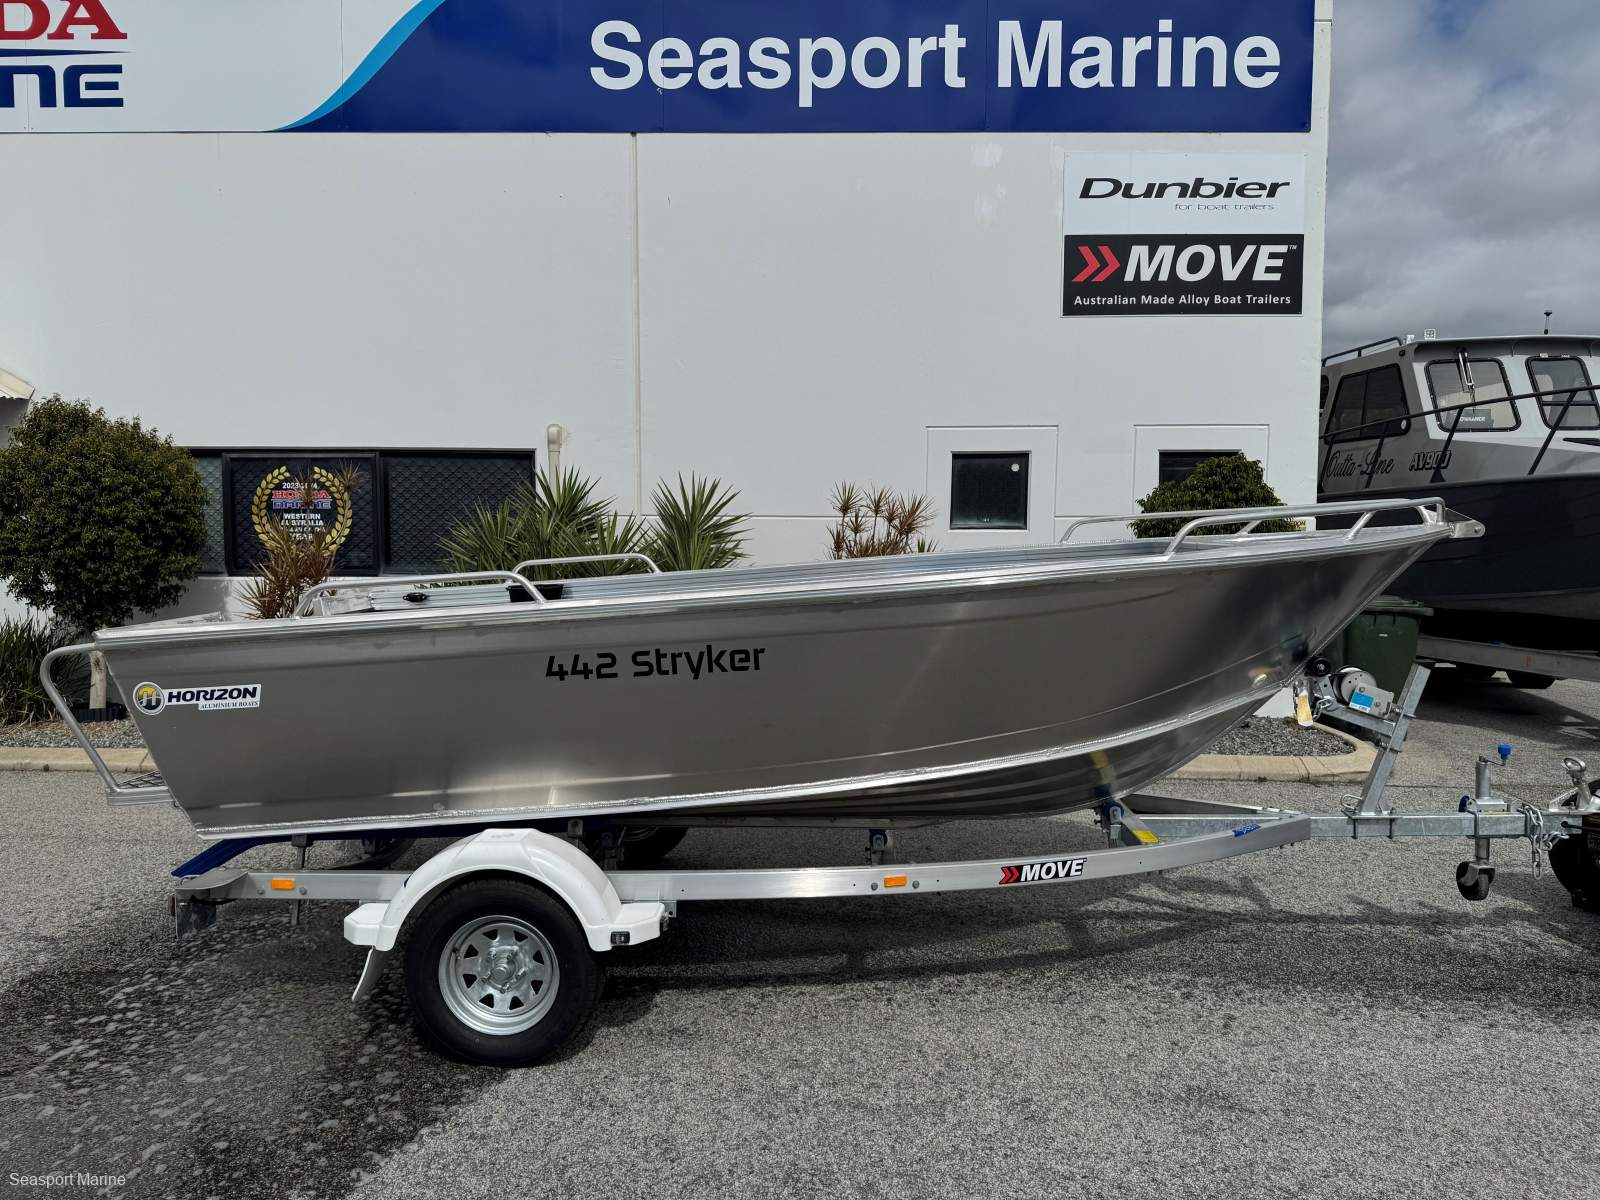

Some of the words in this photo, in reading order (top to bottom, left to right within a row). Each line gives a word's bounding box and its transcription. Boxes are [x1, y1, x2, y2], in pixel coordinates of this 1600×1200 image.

[590, 20, 967, 107] Seasport
[998, 19, 1281, 89] Marine
[1079, 177, 1291, 199] Dunbier
[1175, 203, 1192, 211] for
[1197, 203, 1229, 211] boat
[1234, 203, 1275, 211] trailers
[1124, 244, 1289, 282] MOVE
[1074, 294, 1136, 305] Australian
[1141, 295, 1175, 305] Made
[1179, 294, 1210, 306] Alloy
[1214, 294, 1242, 304] Boat
[1246, 294, 1291, 304] Trailers
[545, 652, 619, 681] 442
[631, 644, 766, 680] Stryker
[168, 686, 258, 703] HORIZON
[201, 702, 238, 710] ALUMINIUM
[1020, 858, 1084, 882] MOVE
